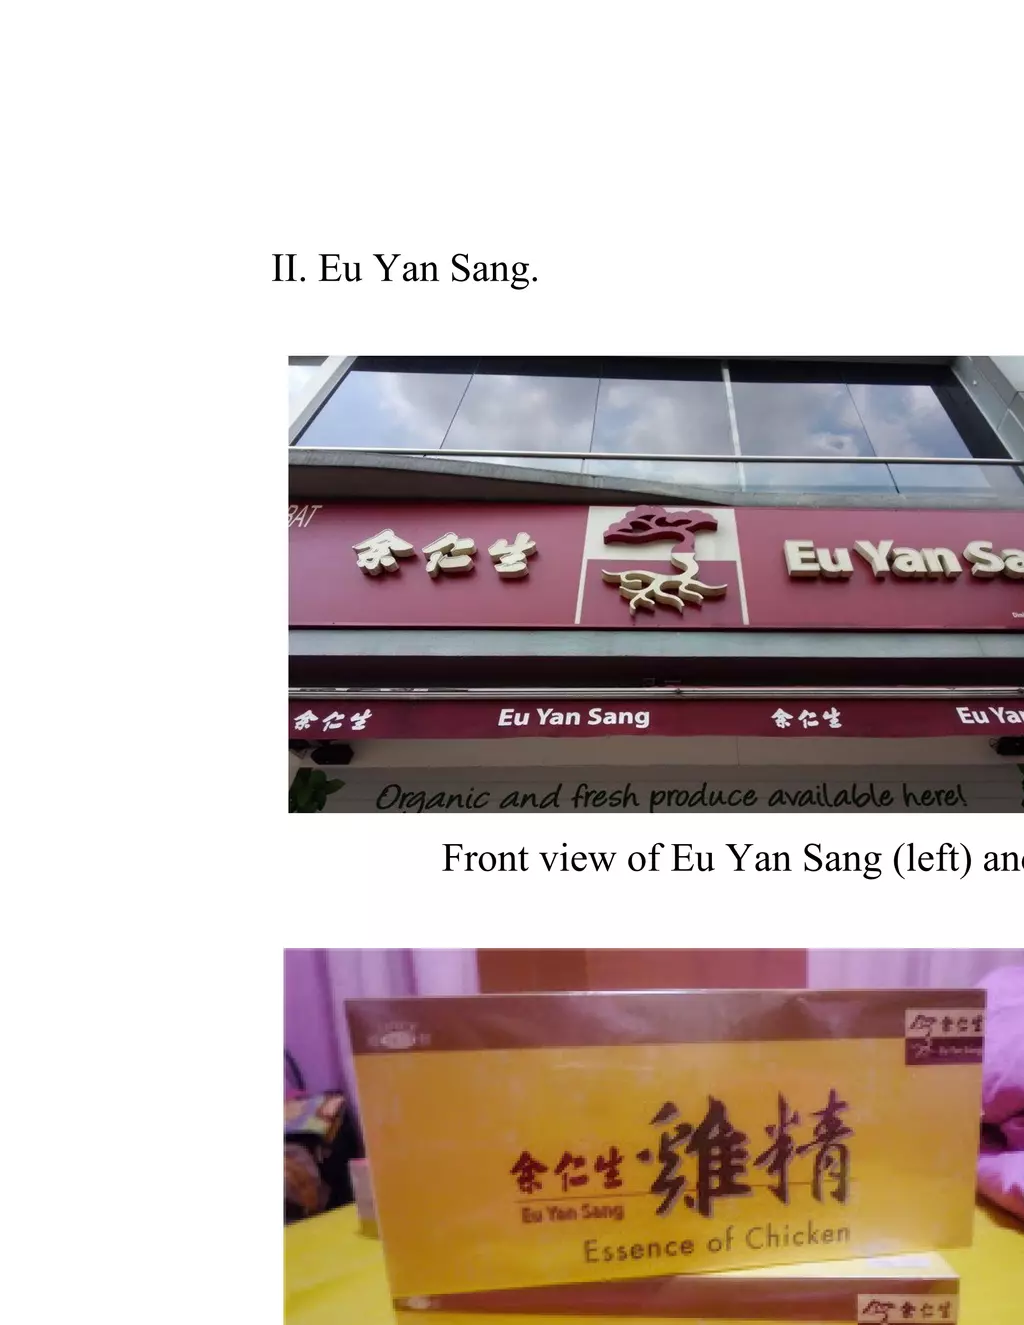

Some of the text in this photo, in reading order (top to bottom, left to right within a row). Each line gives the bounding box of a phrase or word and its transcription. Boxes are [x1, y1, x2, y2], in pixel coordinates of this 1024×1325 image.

[272, 254, 537, 290] II. Eu Yan Sang.
[352, 528, 537, 579] 余仁生
[784, 539, 854, 578] Eu
[852, 539, 963, 578] Yan
[293, 707, 373, 731] 余仁生
[497, 707, 651, 729] Eu Yan Sang
[770, 707, 843, 729] 余仁生
[956, 706, 989, 725] Eu
[375, 782, 968, 813] Organic and fresh produce available here!
[443, 844, 529, 871] Front
[539, 843, 616, 871] view
[628, 843, 664, 871] of
[671, 844, 714, 871] Eu
[726, 844, 791, 871] Yan
[804, 843, 882, 879] Sang
[894, 843, 971, 879] (left)
[510, 1145, 624, 1194] 余仁生
[521, 1203, 625, 1224] Eu Yan Sang
[583, 1220, 850, 1263] Essence of Chicken
